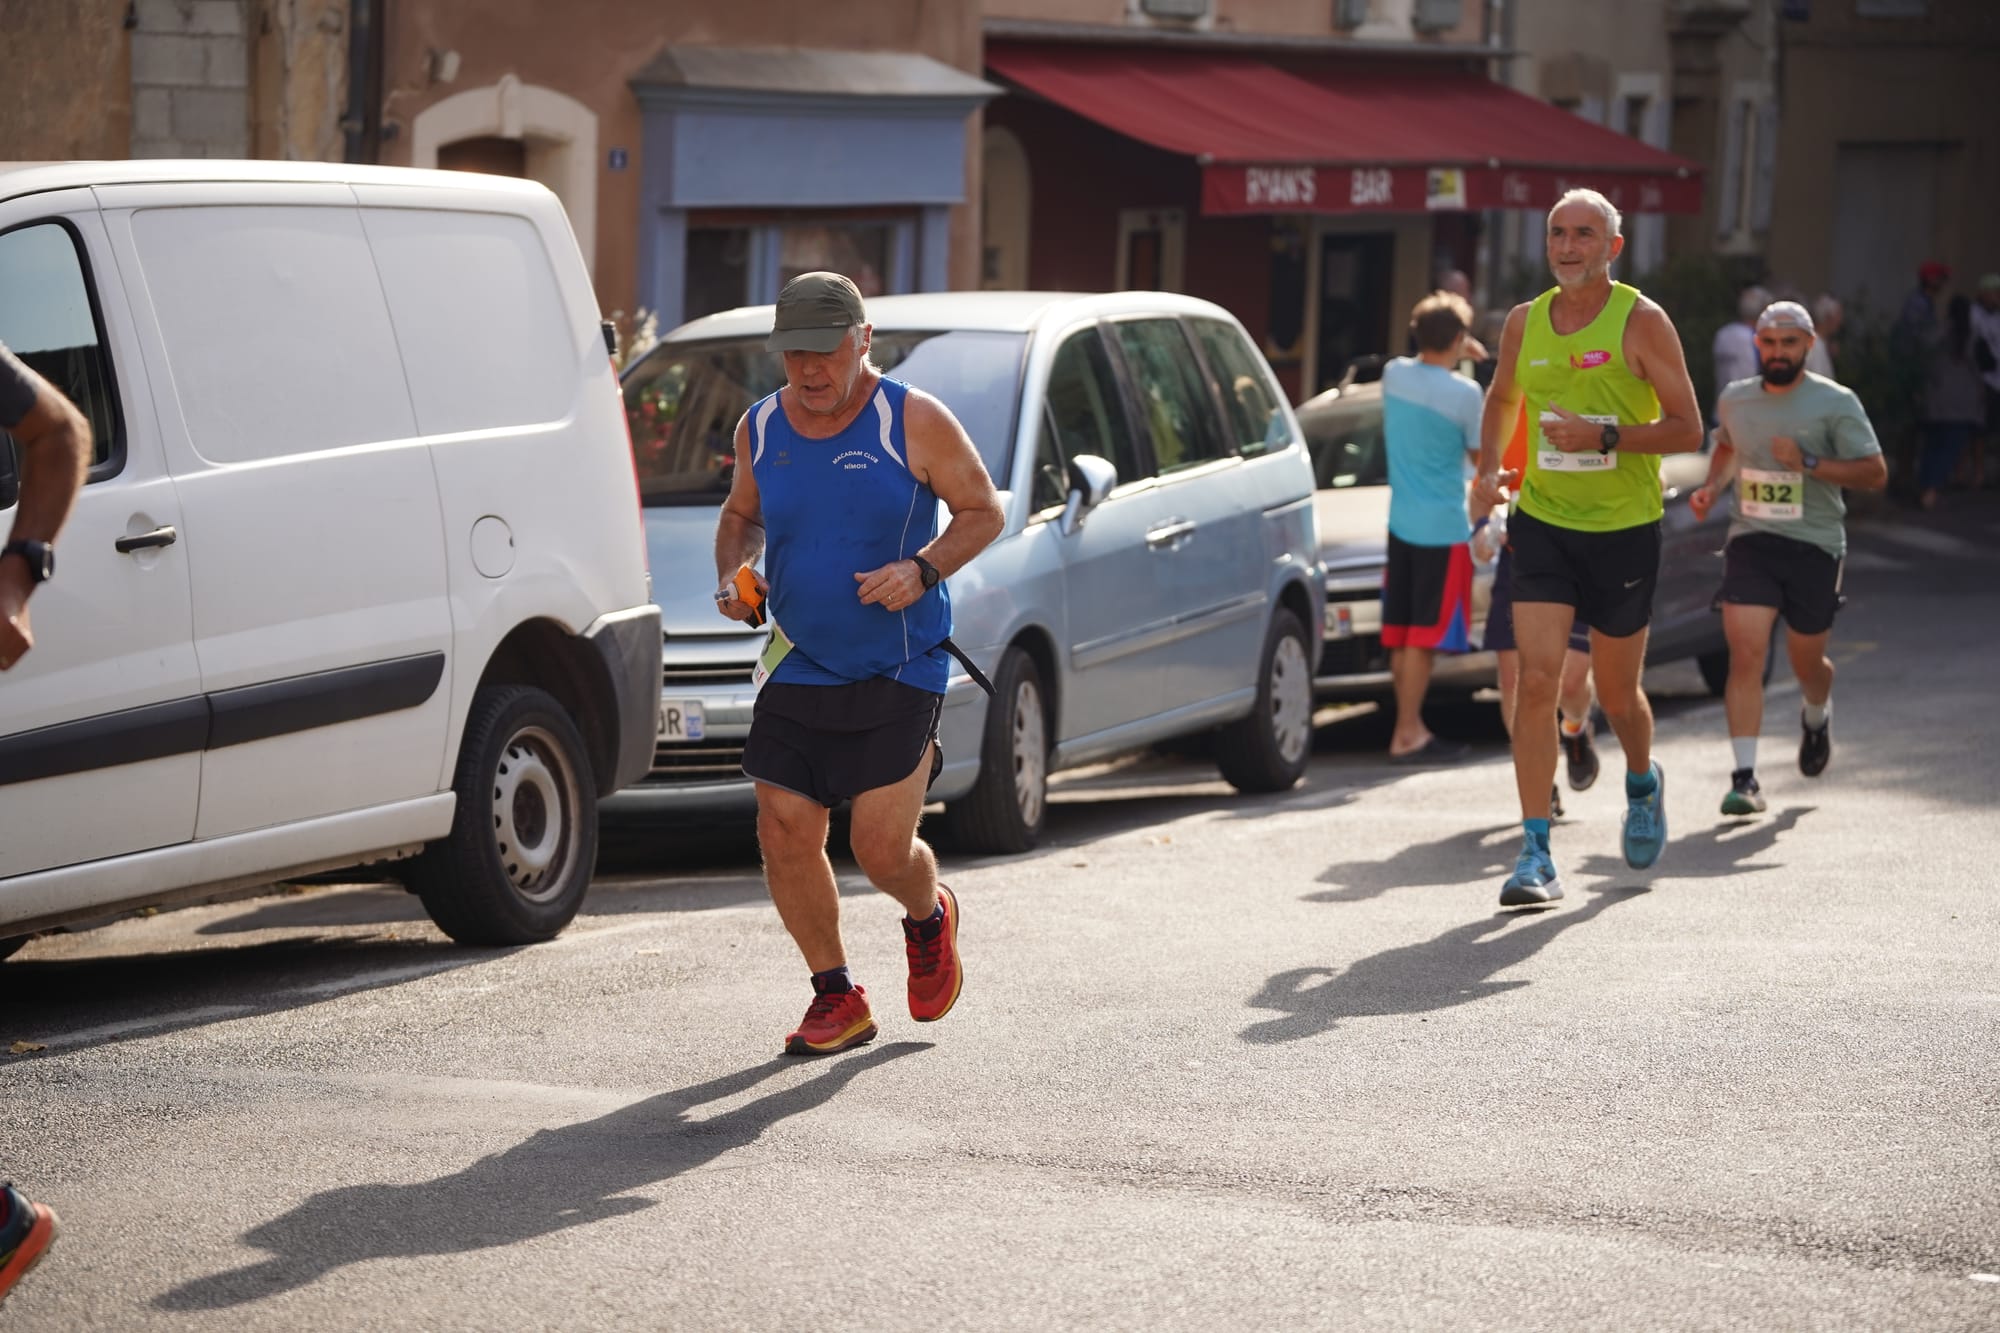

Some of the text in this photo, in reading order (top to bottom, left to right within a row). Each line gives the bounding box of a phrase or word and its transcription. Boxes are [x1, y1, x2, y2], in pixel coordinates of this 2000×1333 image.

[1349, 168, 1394, 205] BAR
[832, 450, 879, 464] MACADAM CLUB
[1749, 482, 1792, 503] 132
